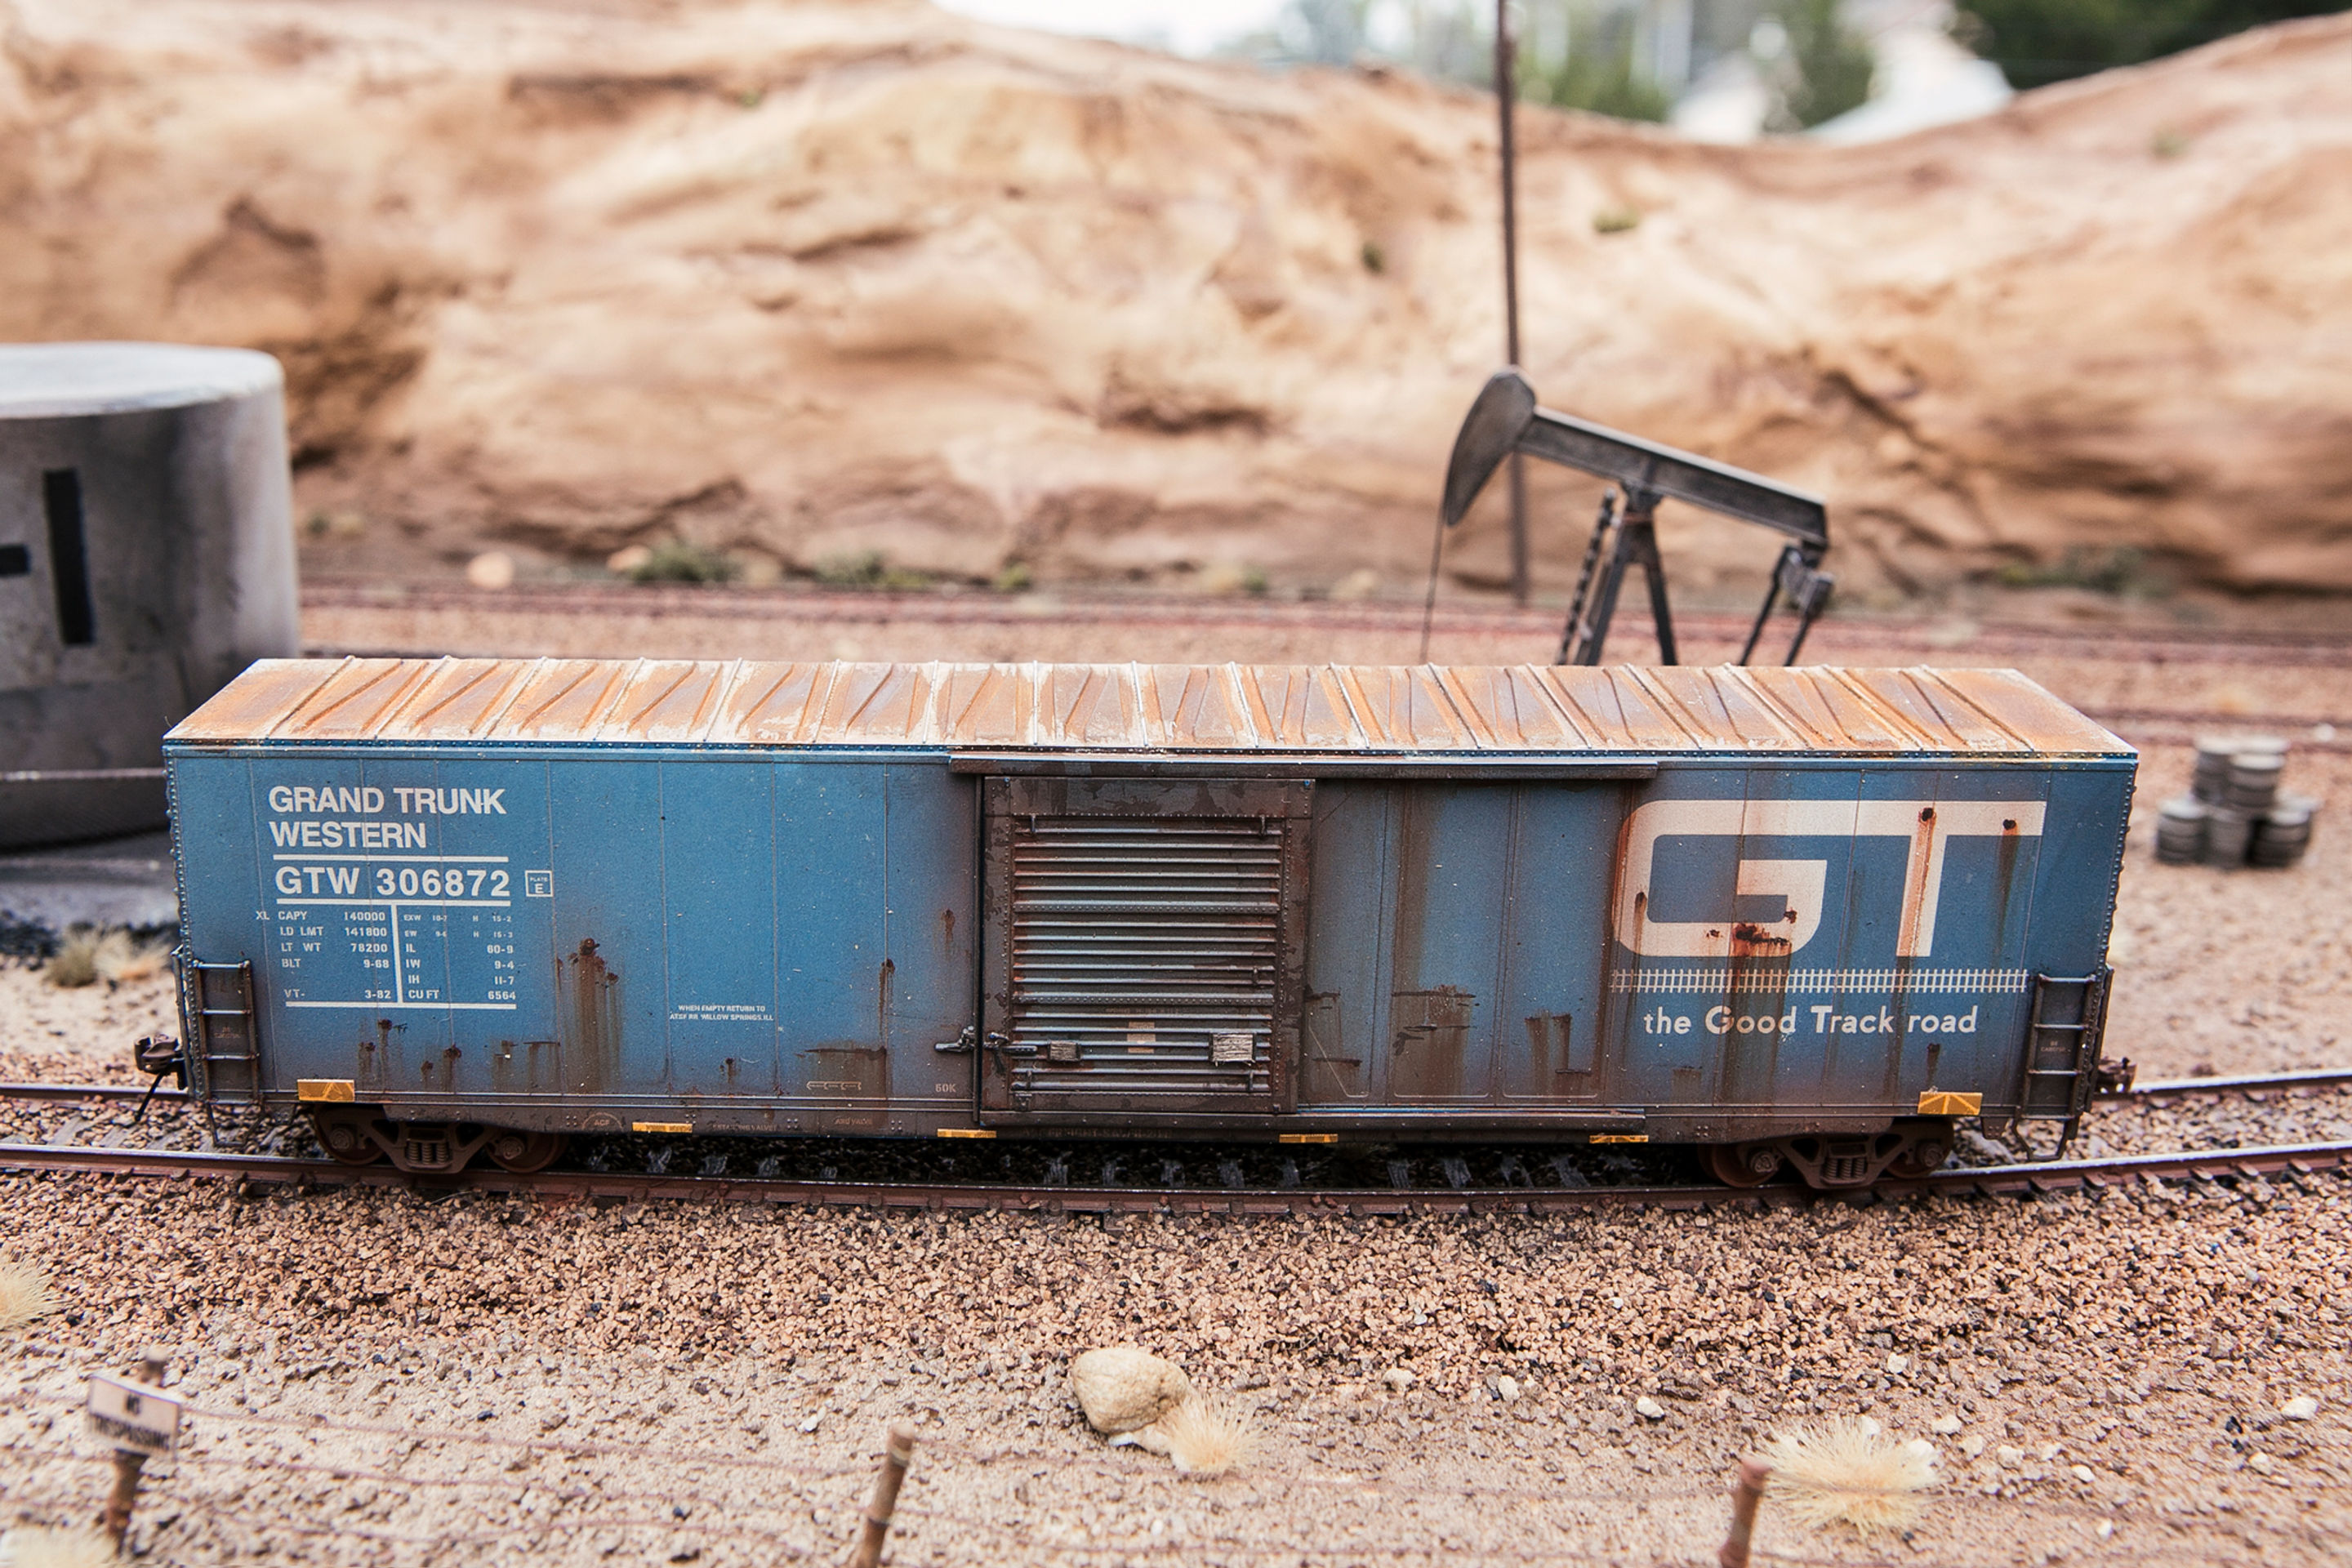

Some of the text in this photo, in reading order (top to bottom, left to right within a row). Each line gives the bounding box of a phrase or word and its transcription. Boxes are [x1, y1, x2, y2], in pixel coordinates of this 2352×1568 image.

[268, 786, 507, 815] GRAND TRUNK
[269, 822, 426, 849] WESTERN
[275, 866, 510, 898] GTW 306872
[1611, 800, 2047, 959] GT
[535, 883, 545, 894] E
[256, 911, 385, 921] XL CAPY 140000
[279, 926, 387, 937] LD LMT 141800
[281, 942, 388, 952] LT WT 78200
[405, 943, 514, 954] IL 60-9
[282, 958, 390, 969] BLT 9-68
[406, 959, 514, 970] IW 9-4
[408, 974, 420, 984] IH
[364, 990, 392, 1000] 3-82
[408, 989, 516, 1000] CU FT 6564
[1643, 1005, 1979, 1036] the Good Track road
